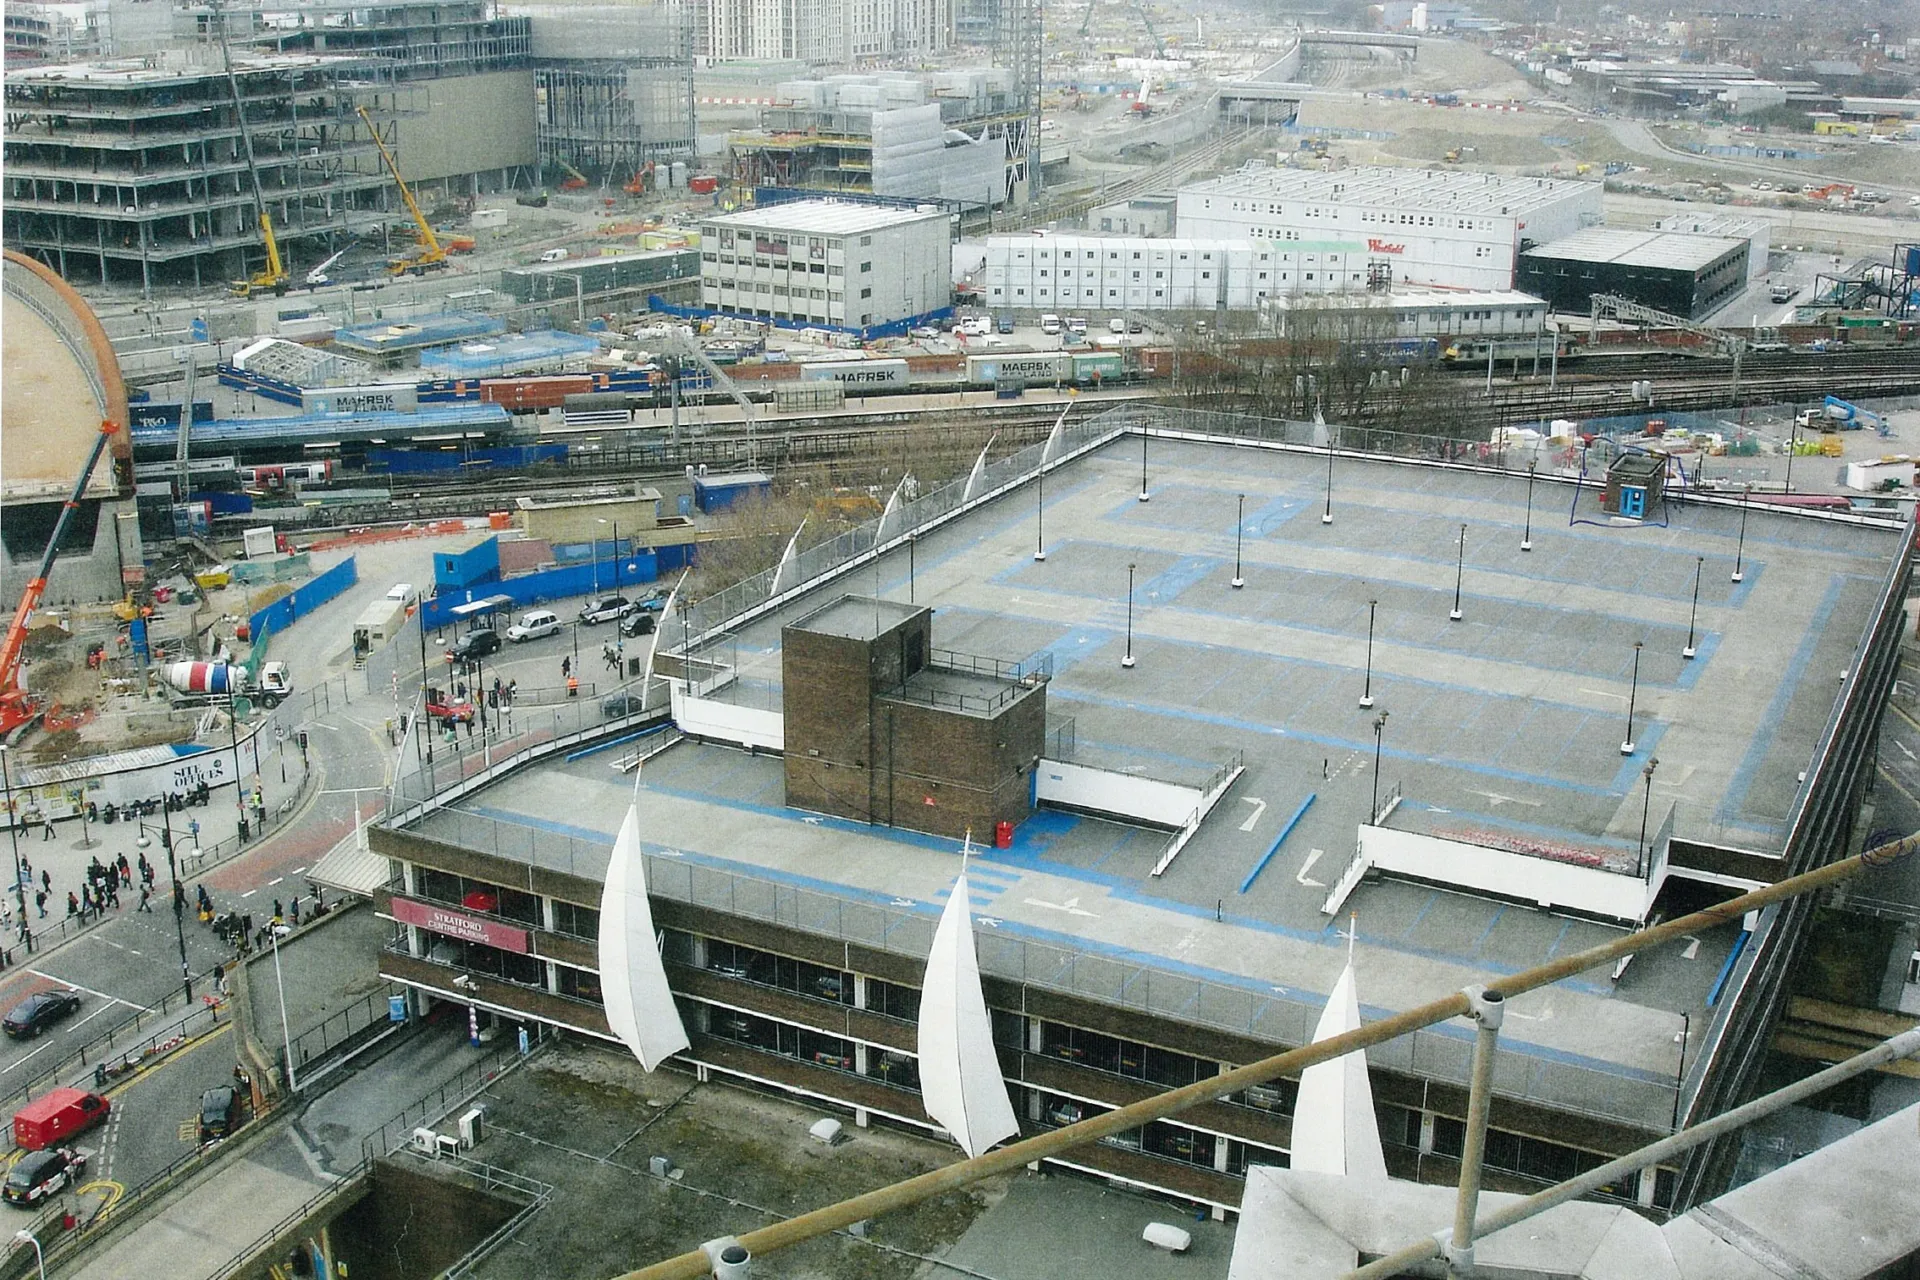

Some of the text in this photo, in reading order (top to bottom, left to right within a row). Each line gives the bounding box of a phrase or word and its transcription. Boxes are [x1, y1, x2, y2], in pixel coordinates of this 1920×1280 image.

[1002, 361, 1051, 372] MAERSK
[835, 371, 895, 382] MAERSK
[337, 394, 393, 406] MAERSK
[174, 765, 201, 778] SITE
[175, 768, 223, 787] OFFICES
[434, 912, 482, 932] STRATFORD
[427, 920, 489, 942] CENTRE PARKING
